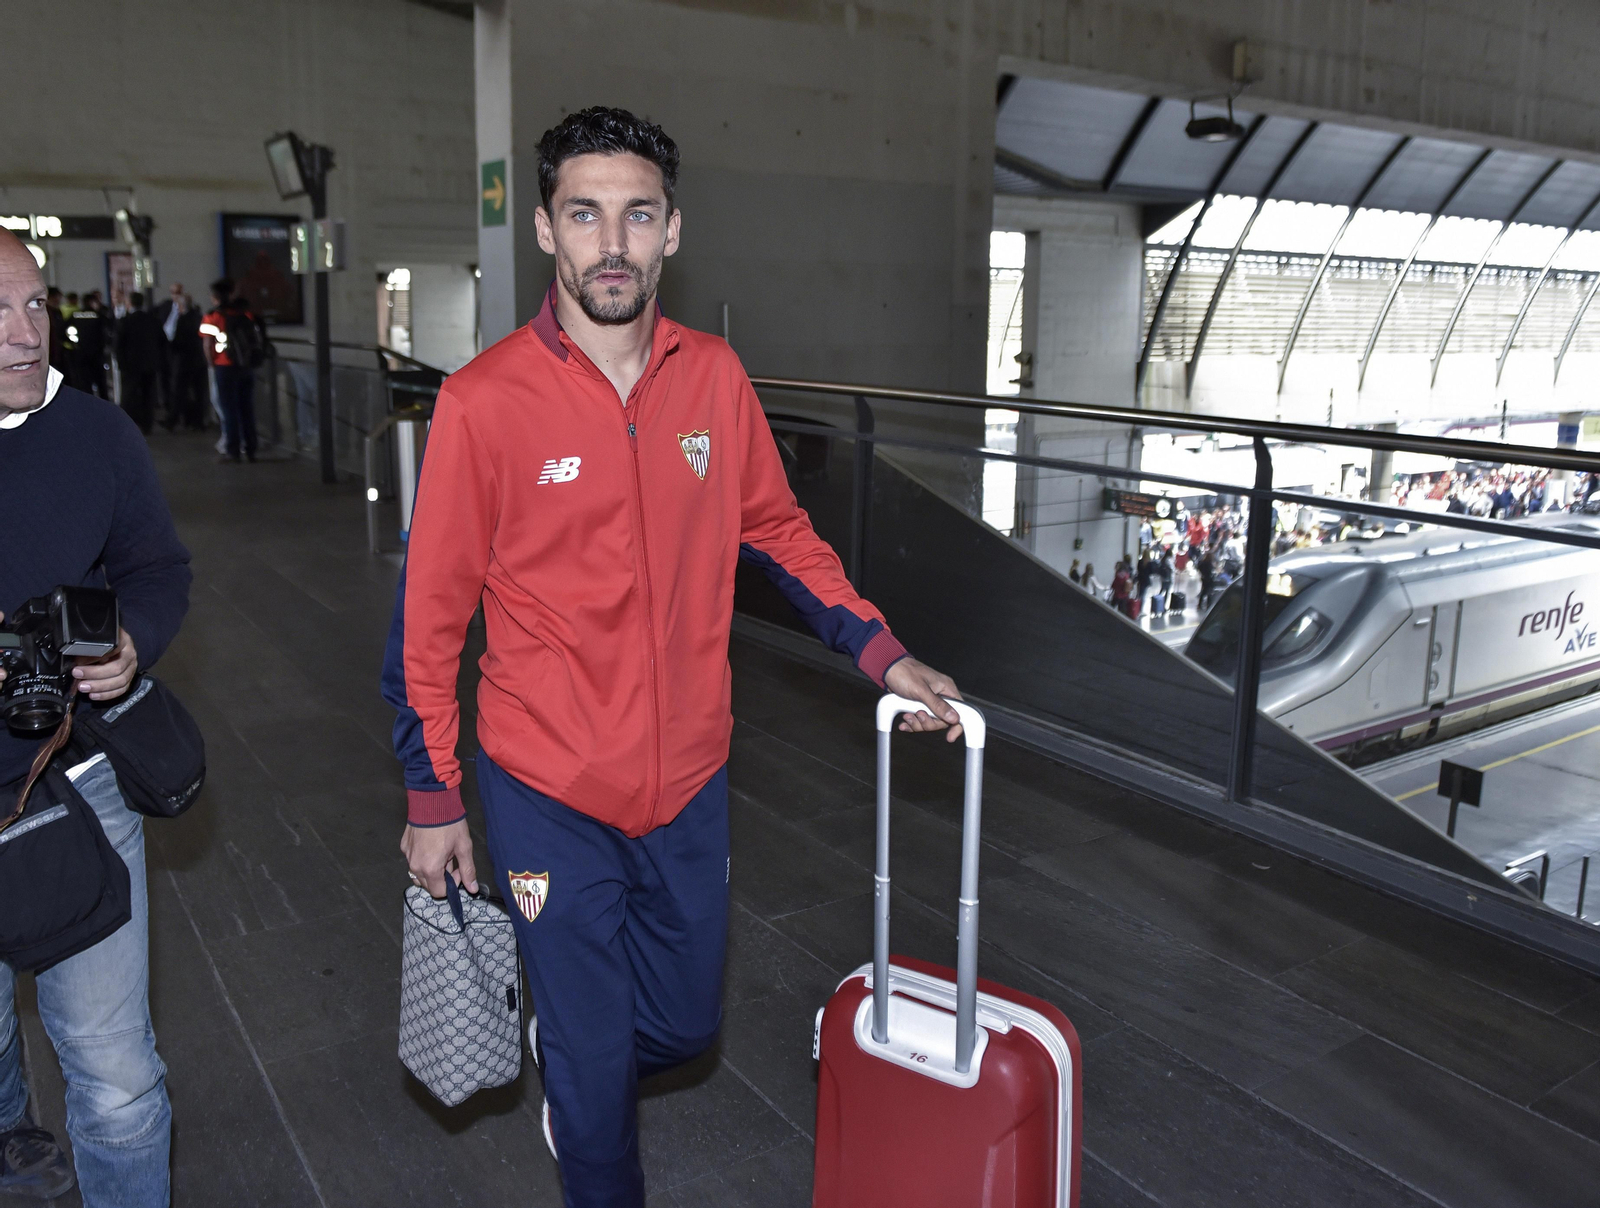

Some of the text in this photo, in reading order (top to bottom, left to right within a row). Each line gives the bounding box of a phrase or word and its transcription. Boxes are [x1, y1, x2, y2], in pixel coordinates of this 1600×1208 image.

[1518, 590, 1584, 641] renfe
[1563, 622, 1598, 655] AVE
[909, 1054, 928, 1064] 16
